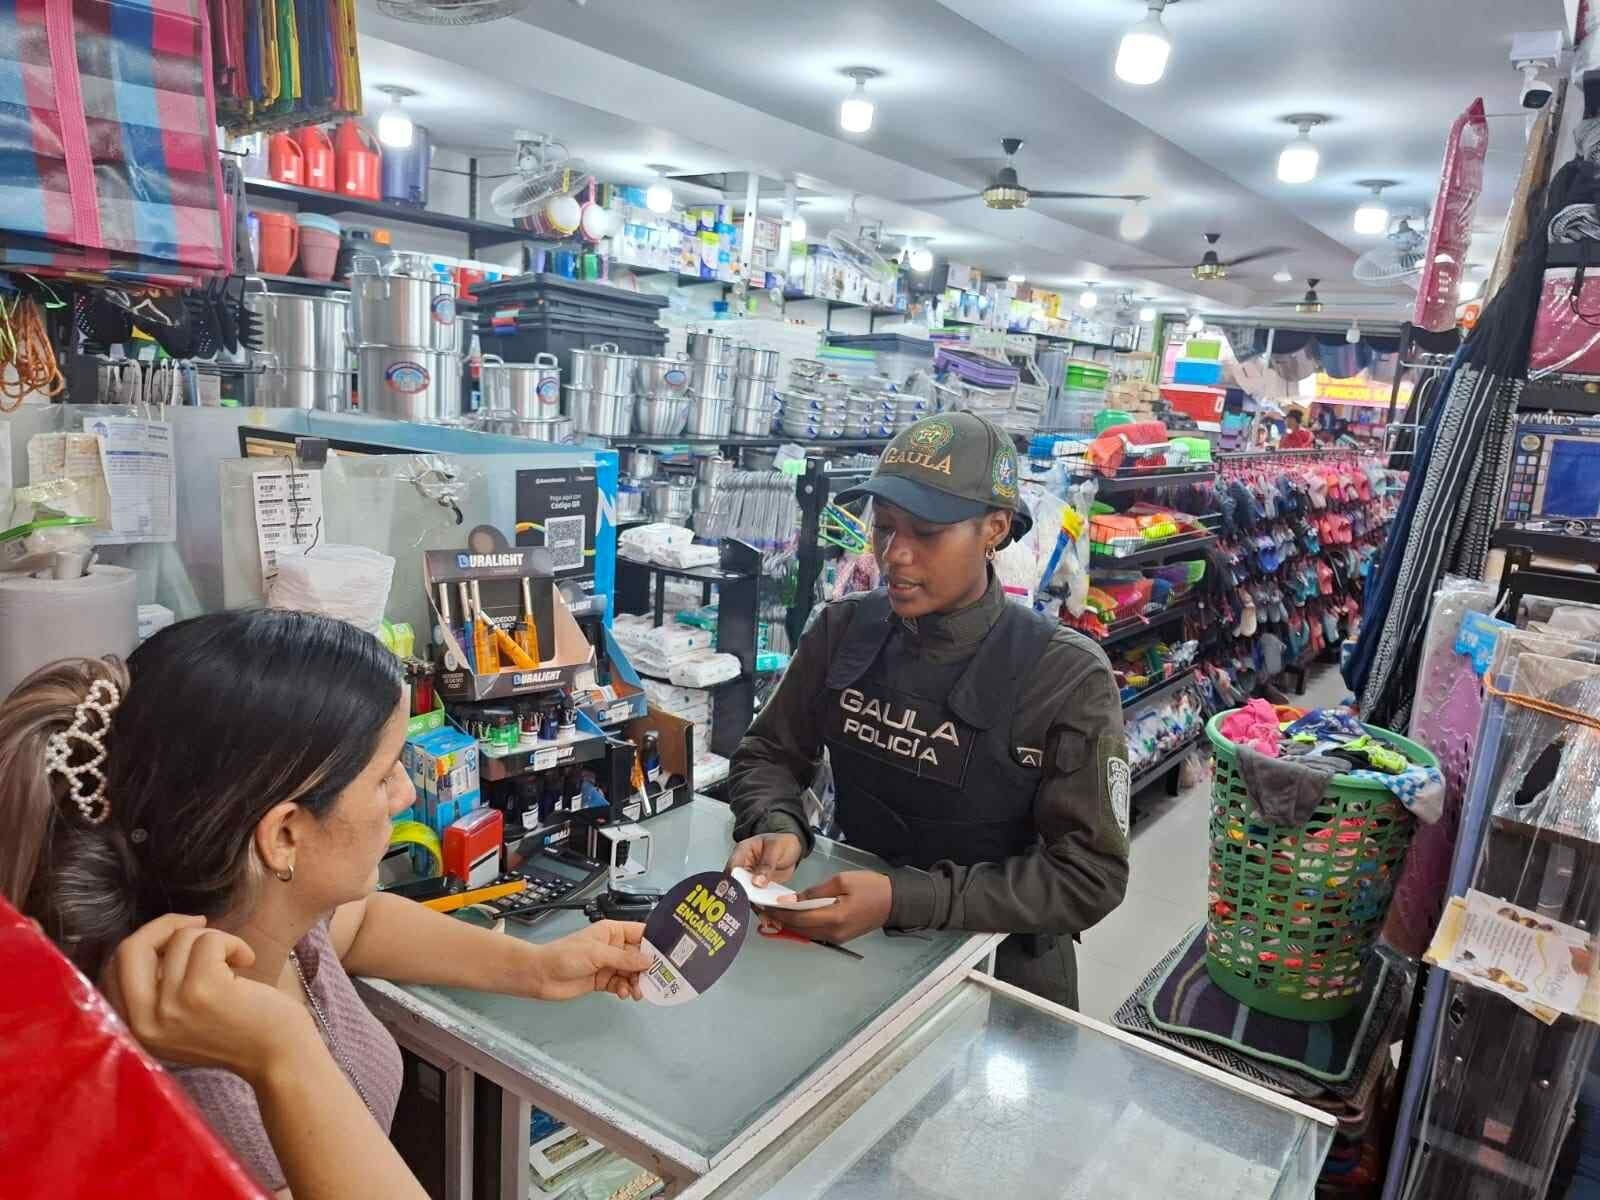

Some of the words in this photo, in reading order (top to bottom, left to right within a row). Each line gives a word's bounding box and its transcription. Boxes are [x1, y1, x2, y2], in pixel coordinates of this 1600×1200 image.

[883, 447, 952, 476] GAULA
[457, 553, 525, 569] DURALIGHT
[839, 687, 960, 747] GAULA
[843, 717, 939, 766] POLICÍA
[675, 902, 727, 957] ENGAÑEN!
